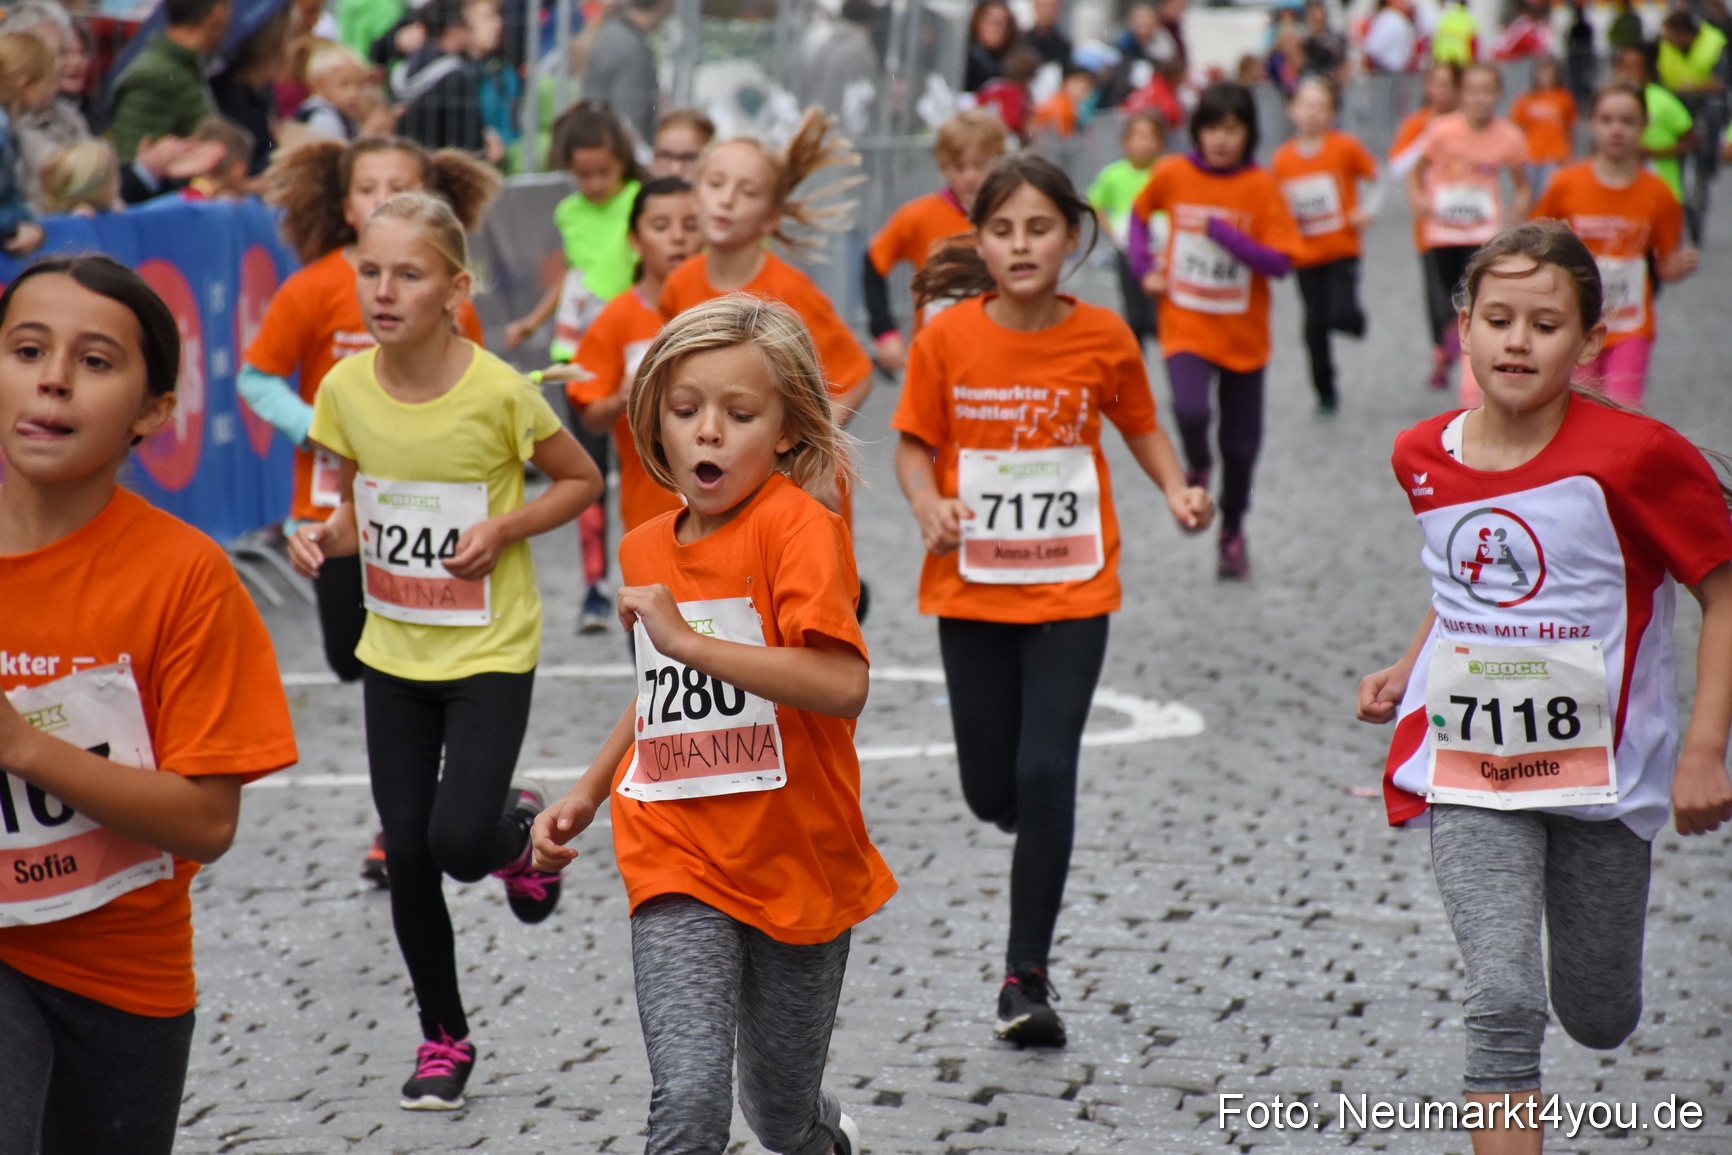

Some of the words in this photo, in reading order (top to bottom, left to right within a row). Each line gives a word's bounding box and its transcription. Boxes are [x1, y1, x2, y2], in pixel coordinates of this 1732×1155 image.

[953, 384, 1050, 401] Neumarkter
[954, 404, 1029, 422] Stadtlauf
[982, 491, 1078, 530] 7173
[369, 519, 459, 568] 7244
[995, 544, 1069, 561] Anna-Lena
[1443, 617, 1488, 635] AUFEN
[1495, 625, 1528, 638] MIT
[1539, 622, 1591, 639] HERZ
[1485, 661, 1548, 675] BOCK
[645, 664, 746, 726] 7280
[1450, 696, 1581, 746] 7118
[1437, 732, 1449, 742] B6
[647, 722, 778, 782] JOHANNA
[1481, 760, 1560, 781] Charlotte
[14, 853, 77, 884] Sofia
